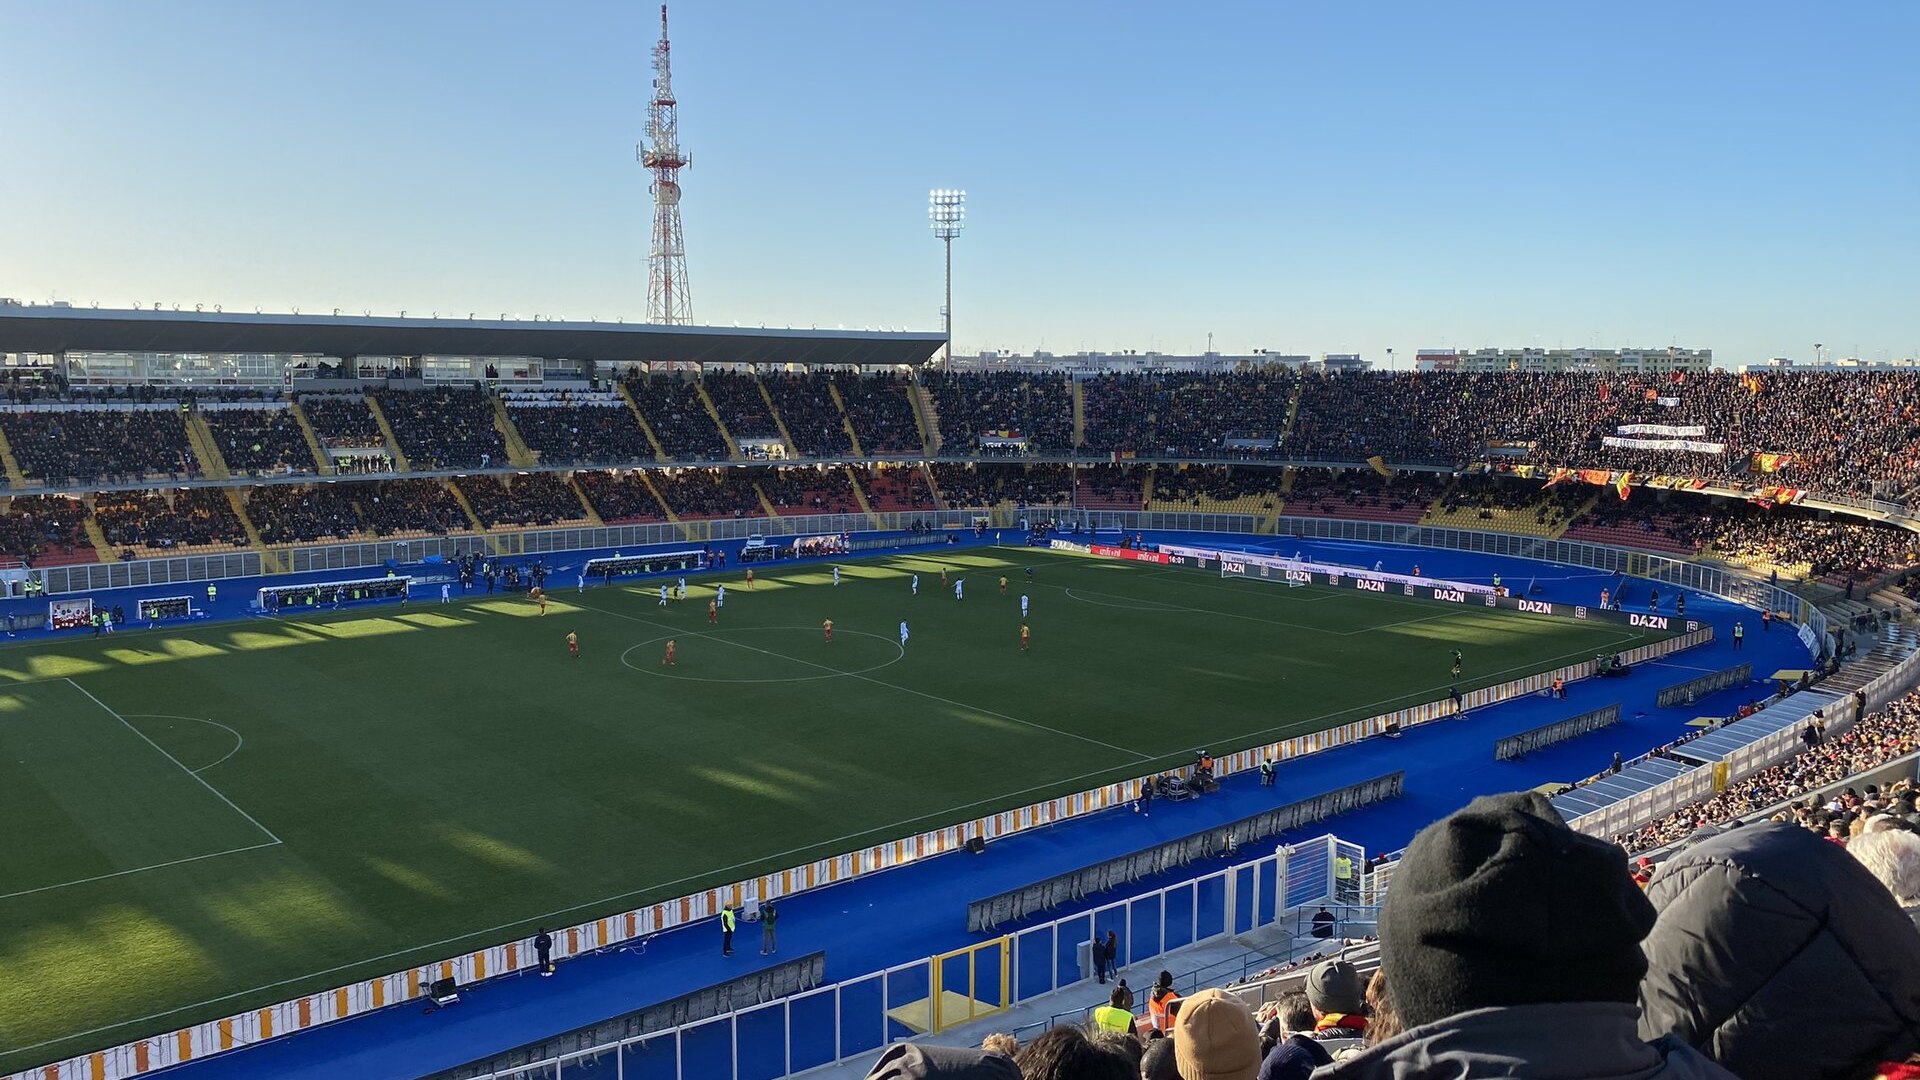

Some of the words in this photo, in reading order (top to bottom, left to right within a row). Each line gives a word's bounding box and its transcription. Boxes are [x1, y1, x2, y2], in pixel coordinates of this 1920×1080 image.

[1168, 555, 1185, 564] 16:01
[1222, 562, 1245, 574] DAZN
[1285, 570, 1311, 583] DAZN
[1357, 579, 1385, 592] DAZN
[1434, 588, 1464, 603] DAZN
[1518, 599, 1552, 614] DAZN
[1630, 613, 1668, 630] DAZN
